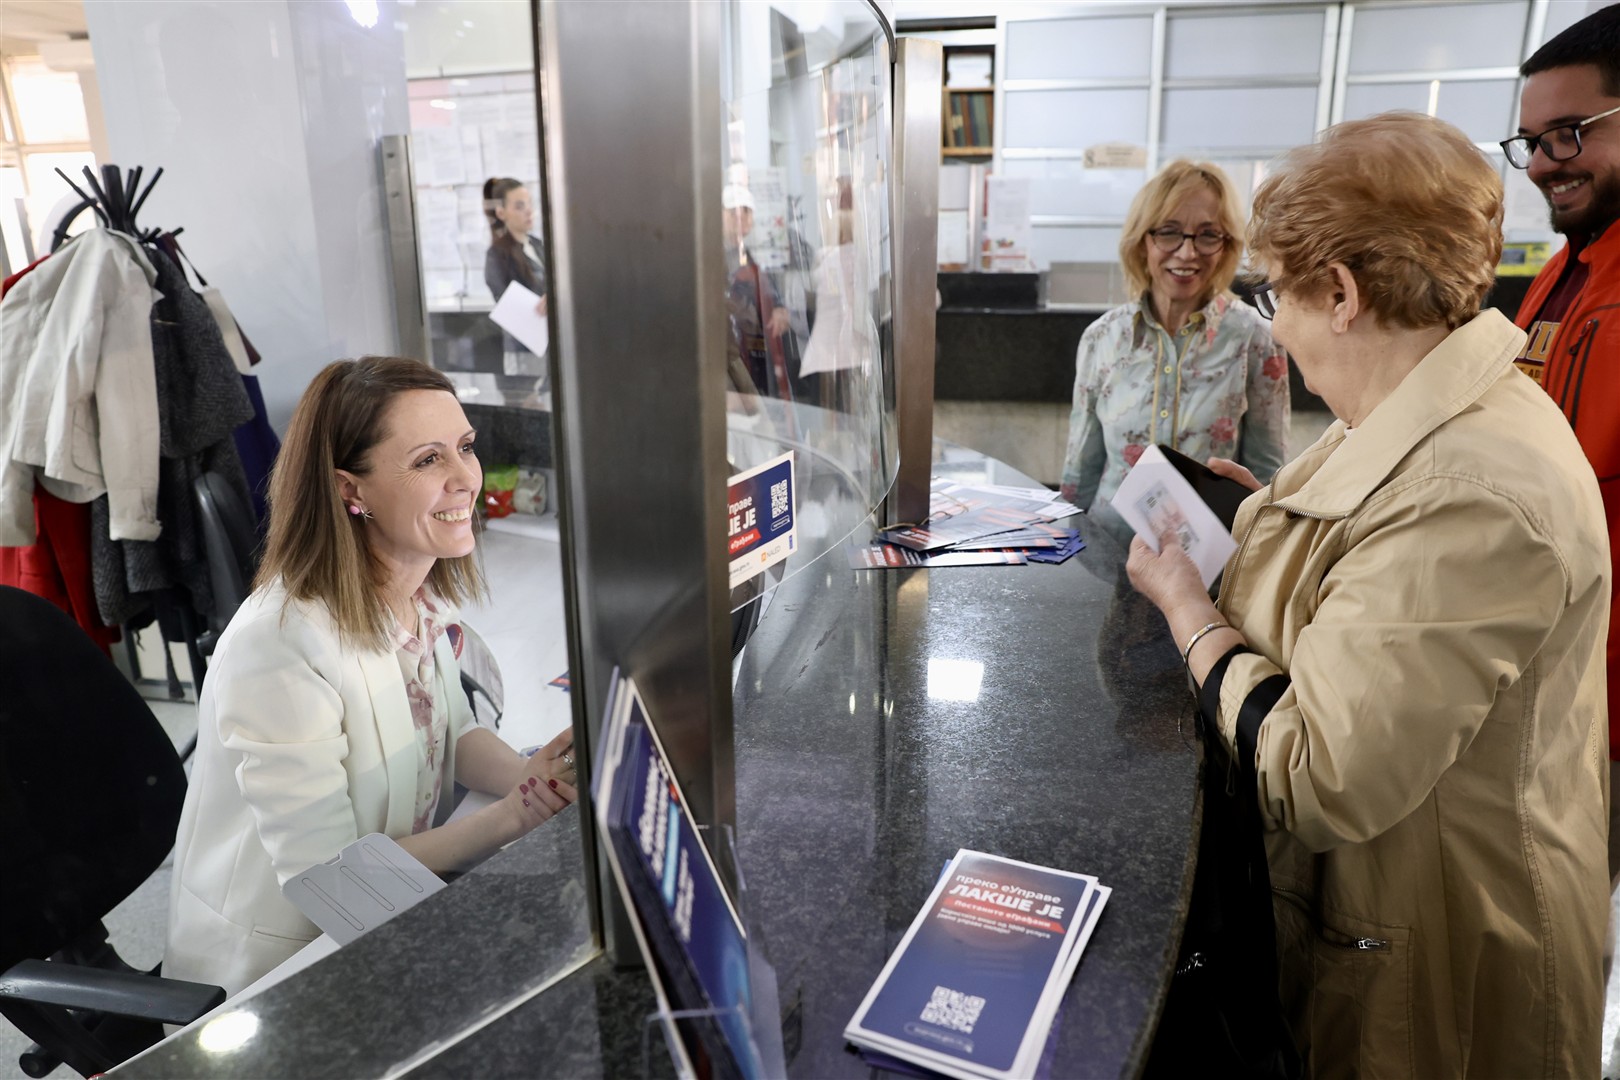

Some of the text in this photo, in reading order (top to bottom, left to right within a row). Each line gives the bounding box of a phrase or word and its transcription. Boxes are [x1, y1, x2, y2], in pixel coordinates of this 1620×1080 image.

[948, 884, 1065, 919] ЛАКШЕ ЈЕ
[955, 874, 1062, 904] преко еУправе
